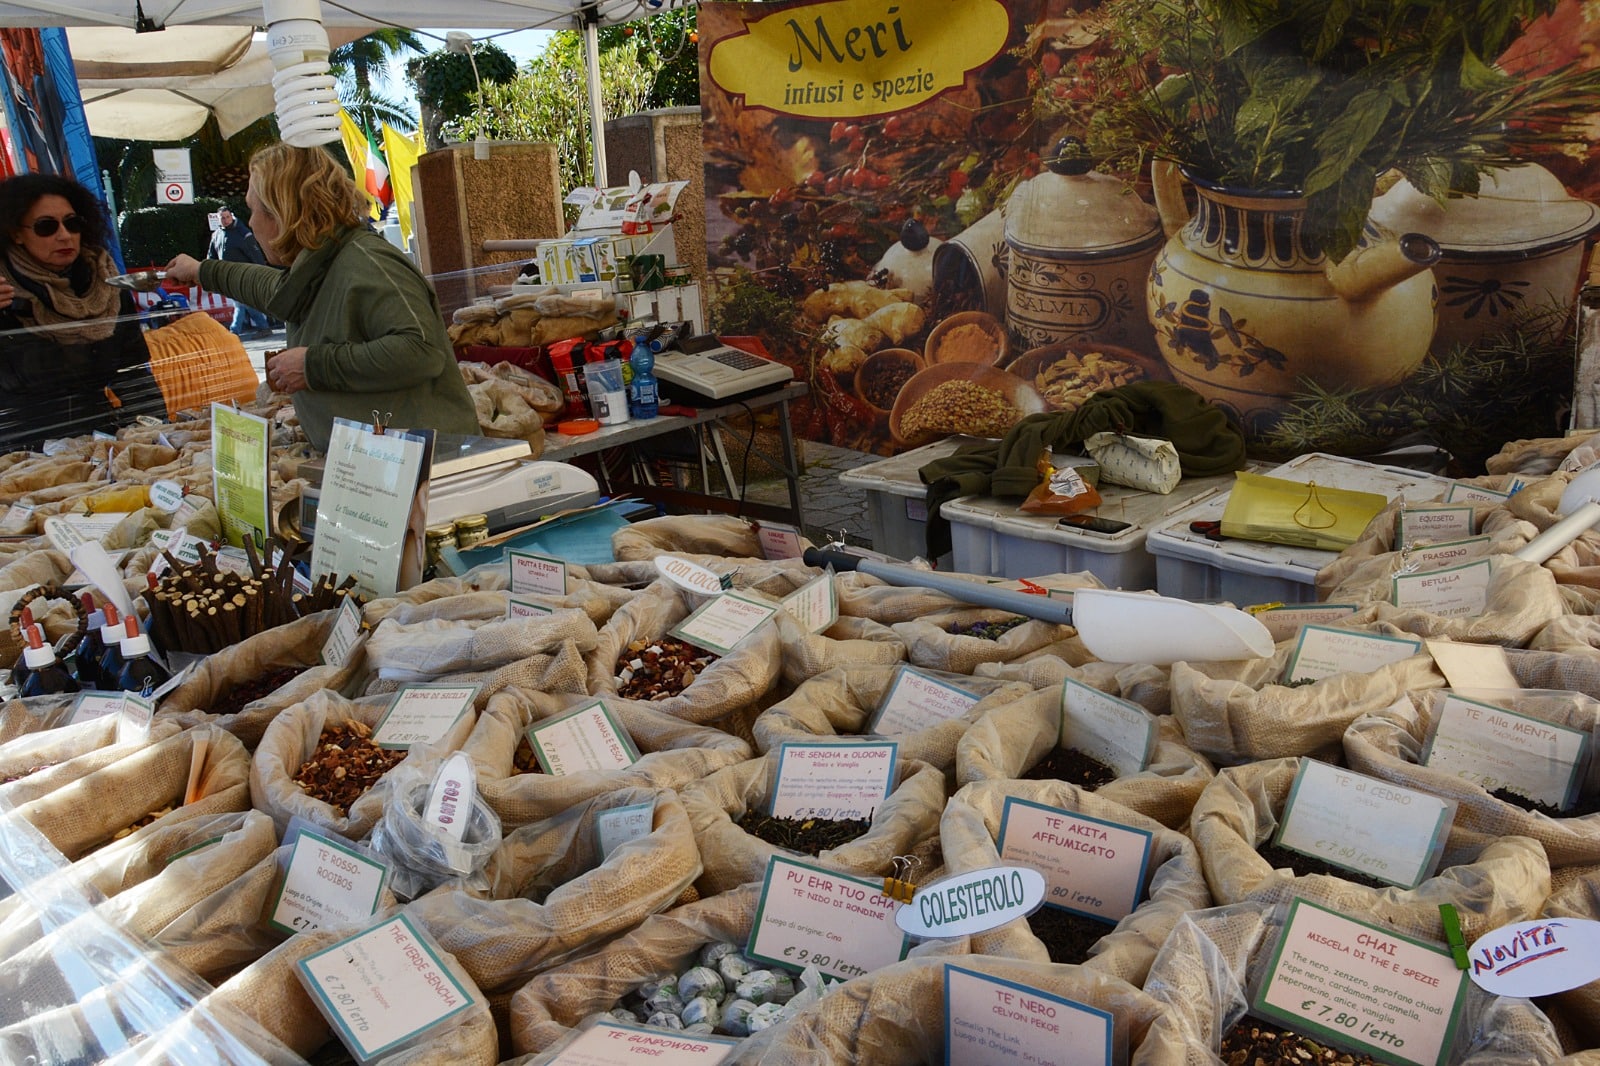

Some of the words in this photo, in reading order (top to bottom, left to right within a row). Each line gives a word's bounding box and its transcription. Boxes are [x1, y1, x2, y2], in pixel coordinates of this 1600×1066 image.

[785, 6, 913, 72] Meri
[783, 79, 844, 105] infusi
[852, 82, 864, 100] e
[871, 68, 934, 103] spezie
[1016, 292, 1091, 317] SALVIA
[1419, 515, 1455, 523] EQUISETO
[517, 558, 538, 569] FRUTTA
[542, 563, 559, 573] FIORI
[1422, 548, 1467, 561] FRASSINO
[1421, 574, 1461, 588] BETULLA
[512, 606, 530, 617] FRAGOLA
[1265, 612, 1298, 622] MENTA
[1301, 612, 1343, 621] PIPERITA
[1325, 635, 1359, 648] MENTA
[1363, 641, 1398, 652] DOLCE
[905, 675, 921, 689] THE
[923, 684, 950, 701] VERDE
[592, 713, 611, 738] ANANAS
[609, 743, 624, 764] PESCA
[1487, 716, 1509, 729] Alla
[1512, 722, 1558, 743] MENTA
[790, 751, 805, 759] THE
[808, 751, 841, 759] SENCHA
[851, 750, 887, 759] OLOONG
[1356, 783, 1367, 792] al
[1370, 786, 1412, 806] CEDRO
[605, 817, 621, 828] THE
[1045, 816, 1064, 830] TE'
[1068, 823, 1108, 841] AKITA
[1032, 831, 1116, 860] AFFUMICATO
[1314, 839, 1326, 849] €
[317, 866, 353, 891] ROOIBOS
[786, 870, 805, 884] PU
[808, 876, 833, 892] EHR
[838, 884, 865, 901] TUO
[869, 895, 896, 912] CHA
[807, 892, 831, 905] NIDO
[833, 899, 843, 909] DI
[846, 903, 885, 921] RONDINE
[919, 870, 1024, 929] COLESTEROLO
[1072, 890, 1103, 908] l'etto
[292, 916, 302, 926] €
[765, 914, 788, 929] Luogo
[788, 919, 796, 929] di
[826, 931, 843, 943] Cina
[783, 946, 796, 957] €
[797, 948, 831, 967] 9,80
[1356, 933, 1398, 957] CHAI
[389, 924, 408, 945] THE
[401, 943, 430, 973] VERDE
[423, 971, 457, 1007] SENCHA
[1306, 931, 1350, 955] MISCELA
[1353, 948, 1366, 961] DI
[1370, 954, 1390, 969] THE
[1392, 962, 1400, 973] E
[1402, 967, 1441, 989] SPEZIE
[1281, 961, 1303, 977] Pepe
[1304, 968, 1327, 986] nero,
[1328, 979, 1380, 1007] cardamomo,
[1382, 1000, 1422, 1023] cannella,
[1291, 951, 1308, 965] The
[1308, 958, 1332, 974] nero,
[1333, 967, 1371, 990] zenzero,
[1372, 984, 1414, 1006] garofano
[1414, 998, 1444, 1016] chiodi
[325, 974, 340, 983] €
[347, 1006, 369, 1032] l'etto
[995, 990, 1015, 1005] TE'
[1019, 997, 1057, 1019] NERO
[1277, 973, 1332, 1002] peperoncino,
[1333, 994, 1359, 1013] anice,
[1361, 1005, 1396, 1026] vaniglia
[992, 1005, 1028, 1024] CELYON
[1030, 1017, 1061, 1034] PEKOE
[1300, 999, 1317, 1011] €
[1317, 1004, 1359, 1029] 7,80
[1360, 1021, 1405, 1049] l'etto
[627, 1034, 709, 1054] GUNPOWDER
[953, 1028, 977, 1043] Luogo
[978, 1036, 987, 1045] di
[988, 1040, 1019, 1057] Origine
[1037, 1056, 1057, 1066] Lank
[1003, 1032, 1020, 1045] Link
[629, 1046, 665, 1057] VERDE
